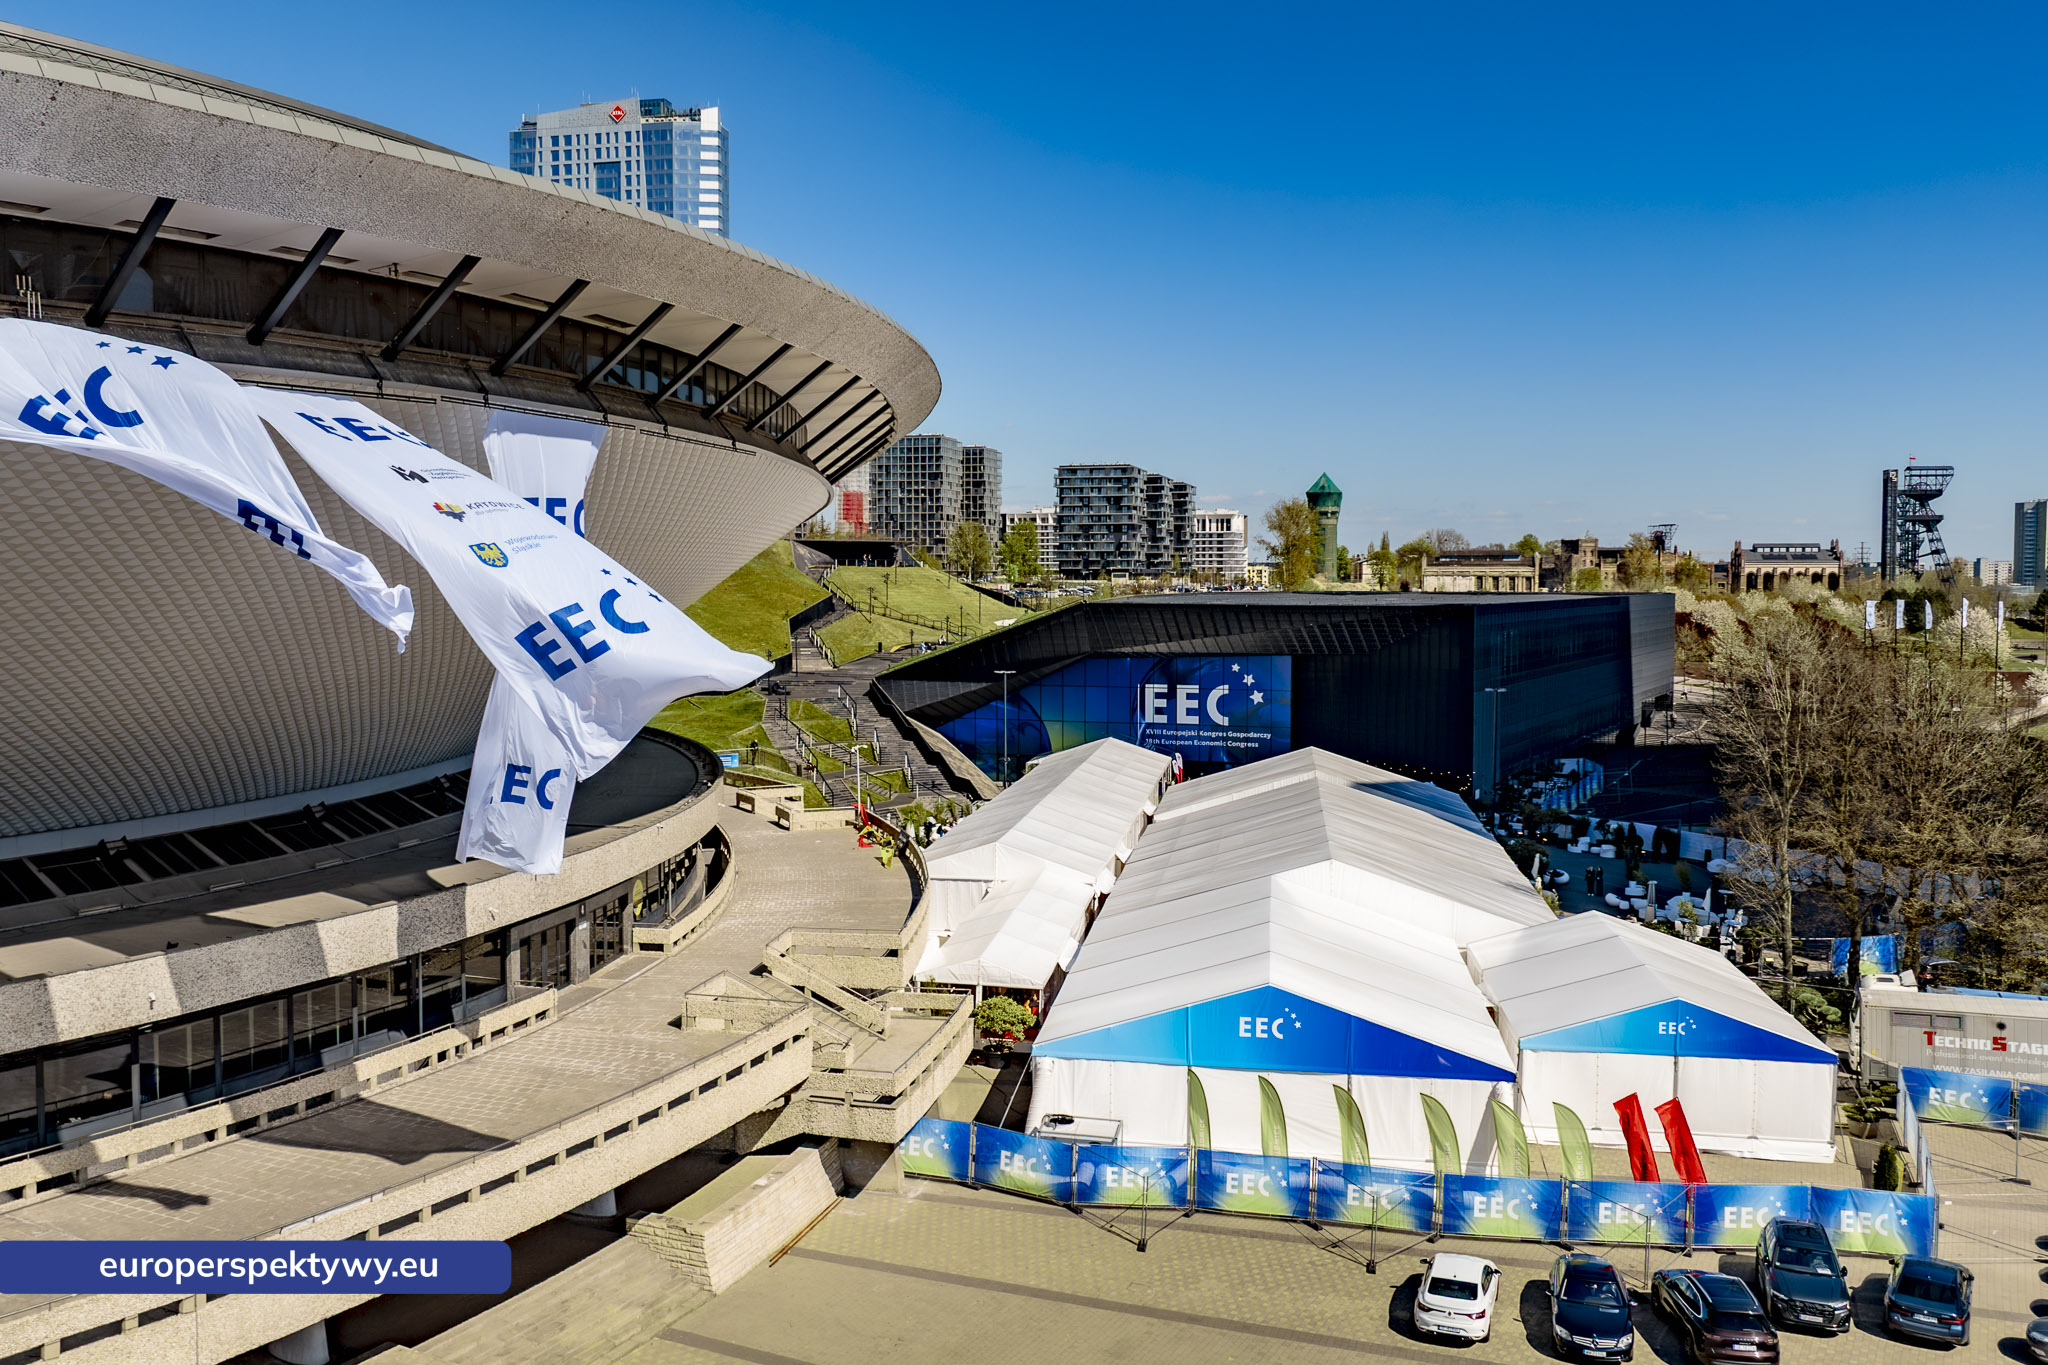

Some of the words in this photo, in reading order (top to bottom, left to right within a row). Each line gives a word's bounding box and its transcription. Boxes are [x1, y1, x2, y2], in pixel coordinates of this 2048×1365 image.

[466, 501, 526, 510] KATOWICE
[514, 588, 650, 682] EEC
[1145, 684, 1229, 727] EEC
[1163, 729, 1198, 737] Europejski
[1200, 730, 1226, 738] Kongres
[1228, 731, 1271, 739] Gospodarczy
[1239, 1016, 1284, 1039] EEC
[1659, 1021, 1686, 1036] EEC
[1926, 1048, 1976, 1060] Professional
[1928, 1087, 1972, 1109] EEC
[1000, 1149, 1037, 1177] EEC
[1106, 1166, 1149, 1189] EEC
[1226, 1172, 1271, 1197] EEC
[1347, 1183, 1394, 1210] EEC
[1473, 1196, 1520, 1221] EEC
[1599, 1202, 1656, 1227] EEC
[1724, 1206, 1769, 1229] EEC
[1840, 1209, 1888, 1236] EEC
